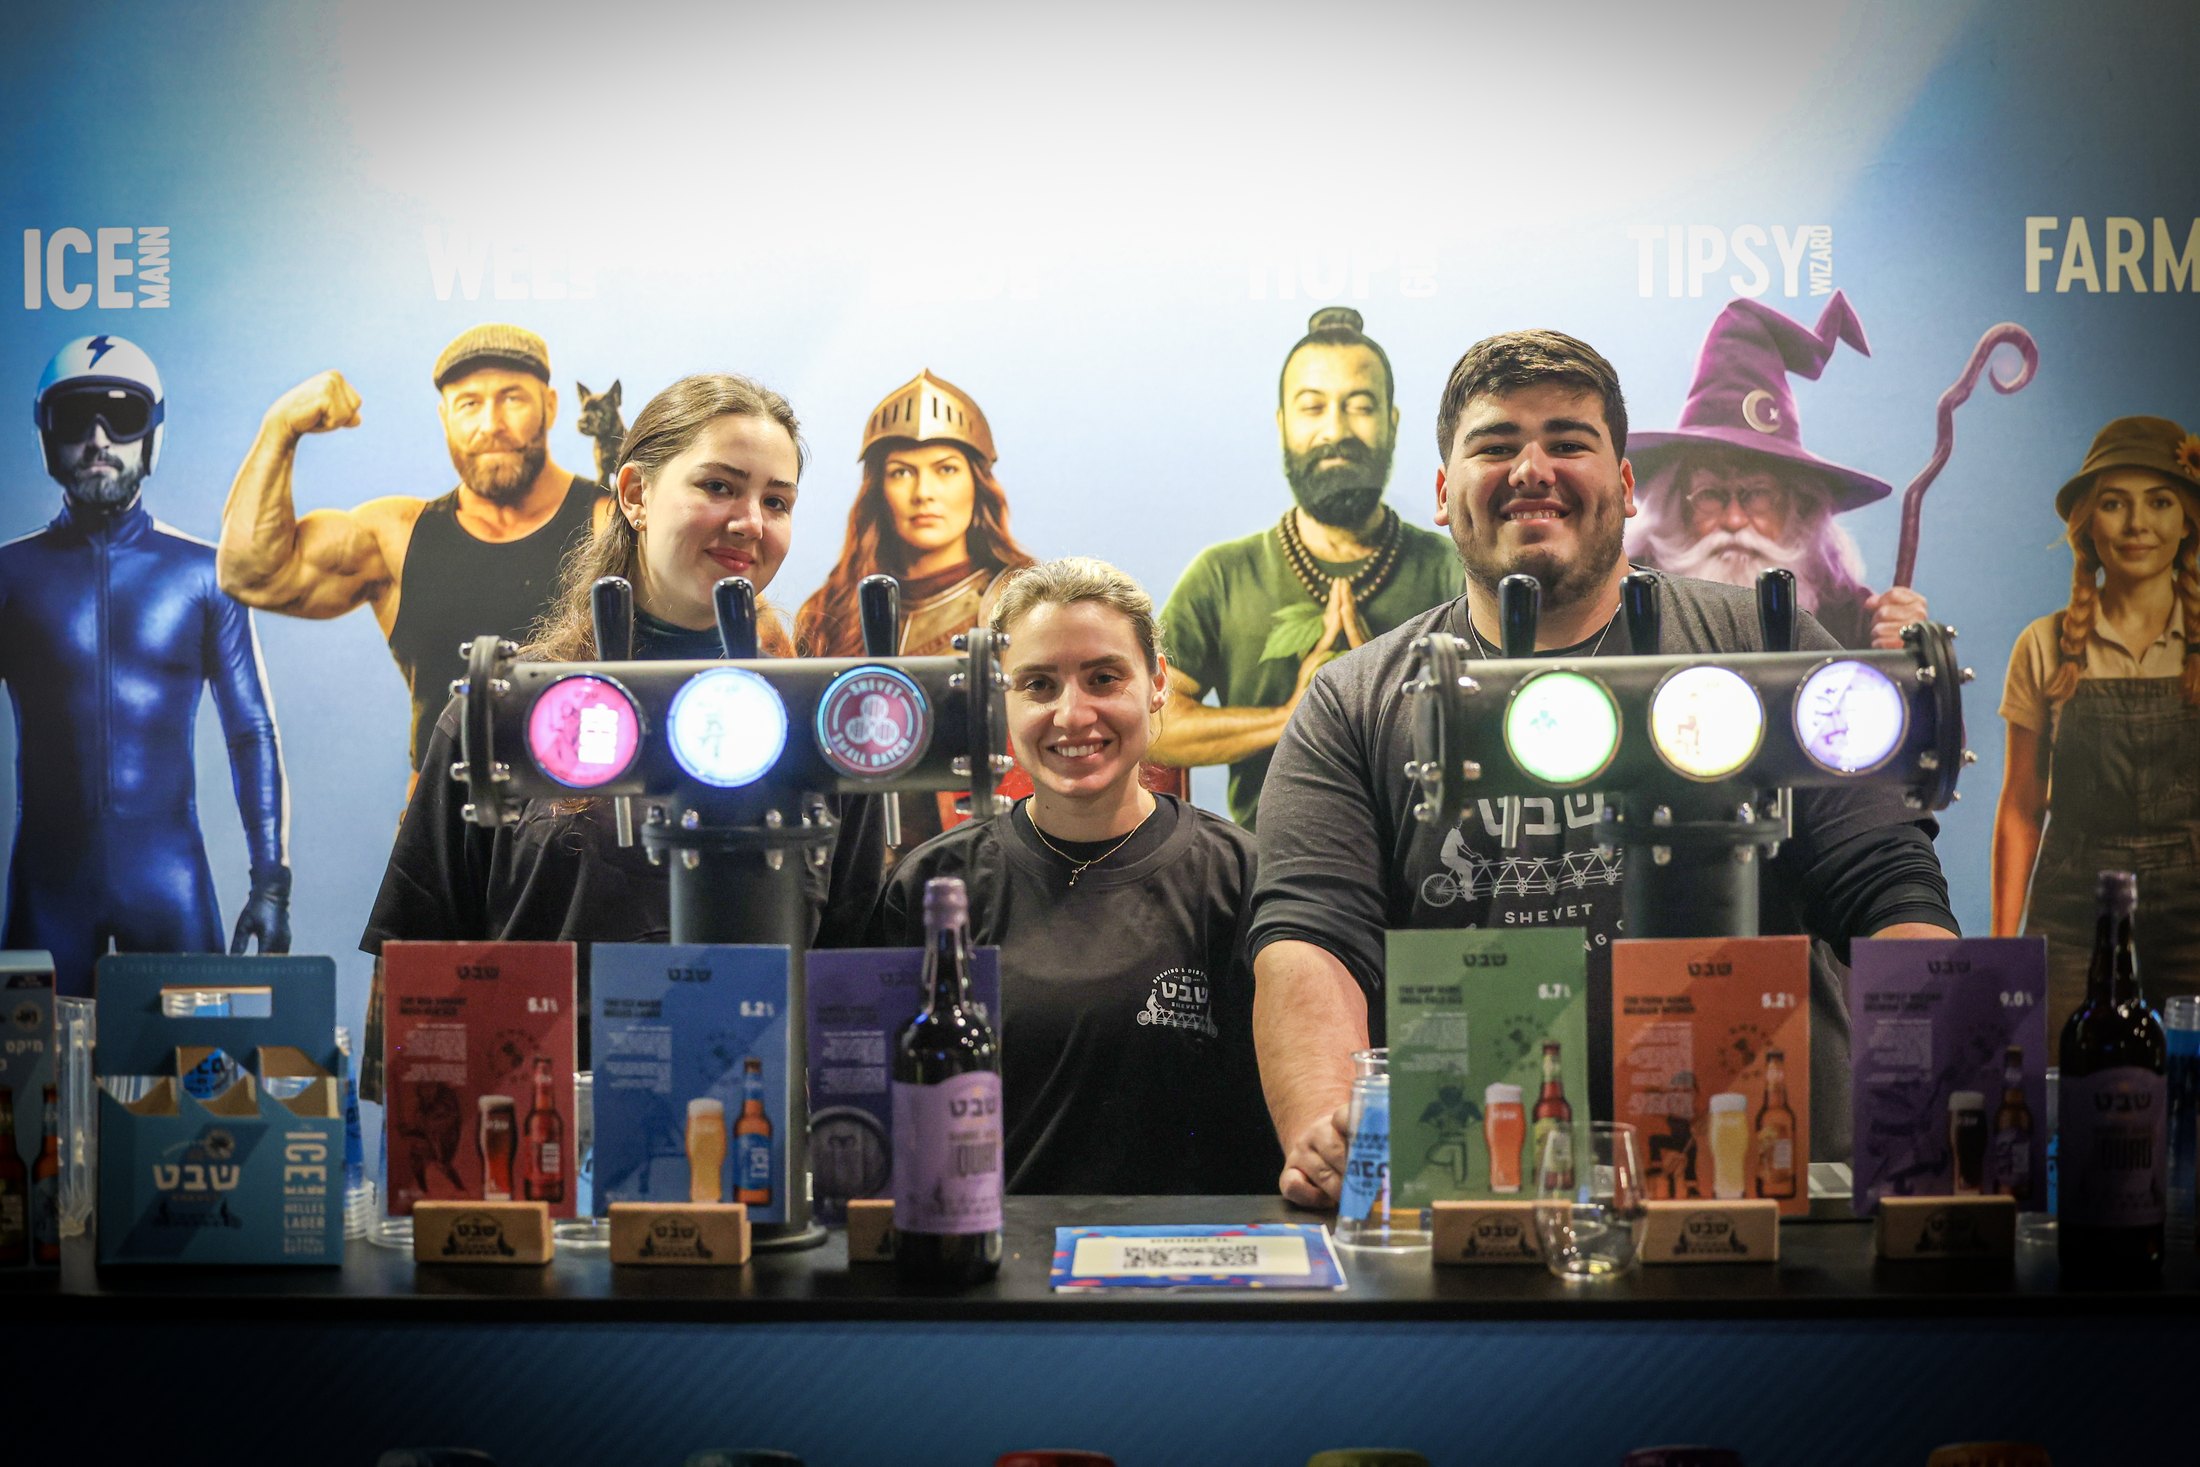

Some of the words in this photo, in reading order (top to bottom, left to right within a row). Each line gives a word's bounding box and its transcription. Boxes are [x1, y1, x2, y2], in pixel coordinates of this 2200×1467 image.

[1627, 224, 1813, 298] TIPSY
[1809, 225, 1833, 296] WIZARD
[2025, 216, 2200, 293] FARM
[24, 227, 134, 310] ICE
[138, 226, 170, 309] MANN
[848, 678, 904, 698] SHEVET
[1504, 903, 1594, 925] SHEVET
[1462, 952, 1508, 968] שבט
[1927, 959, 1971, 975] שבט
[667, 968, 712, 983] שבט
[1152, 967, 1179, 985] BREWING
[1687, 962, 1733, 978] שבט
[1161, 981, 1209, 1004] שבט
[284, 1132, 328, 1182] ICE
[152, 1164, 241, 1191] שבט
[654, 1223, 696, 1238] שבט
[1477, 1224, 1519, 1238] שבט
[1689, 1221, 1729, 1236] שבט
